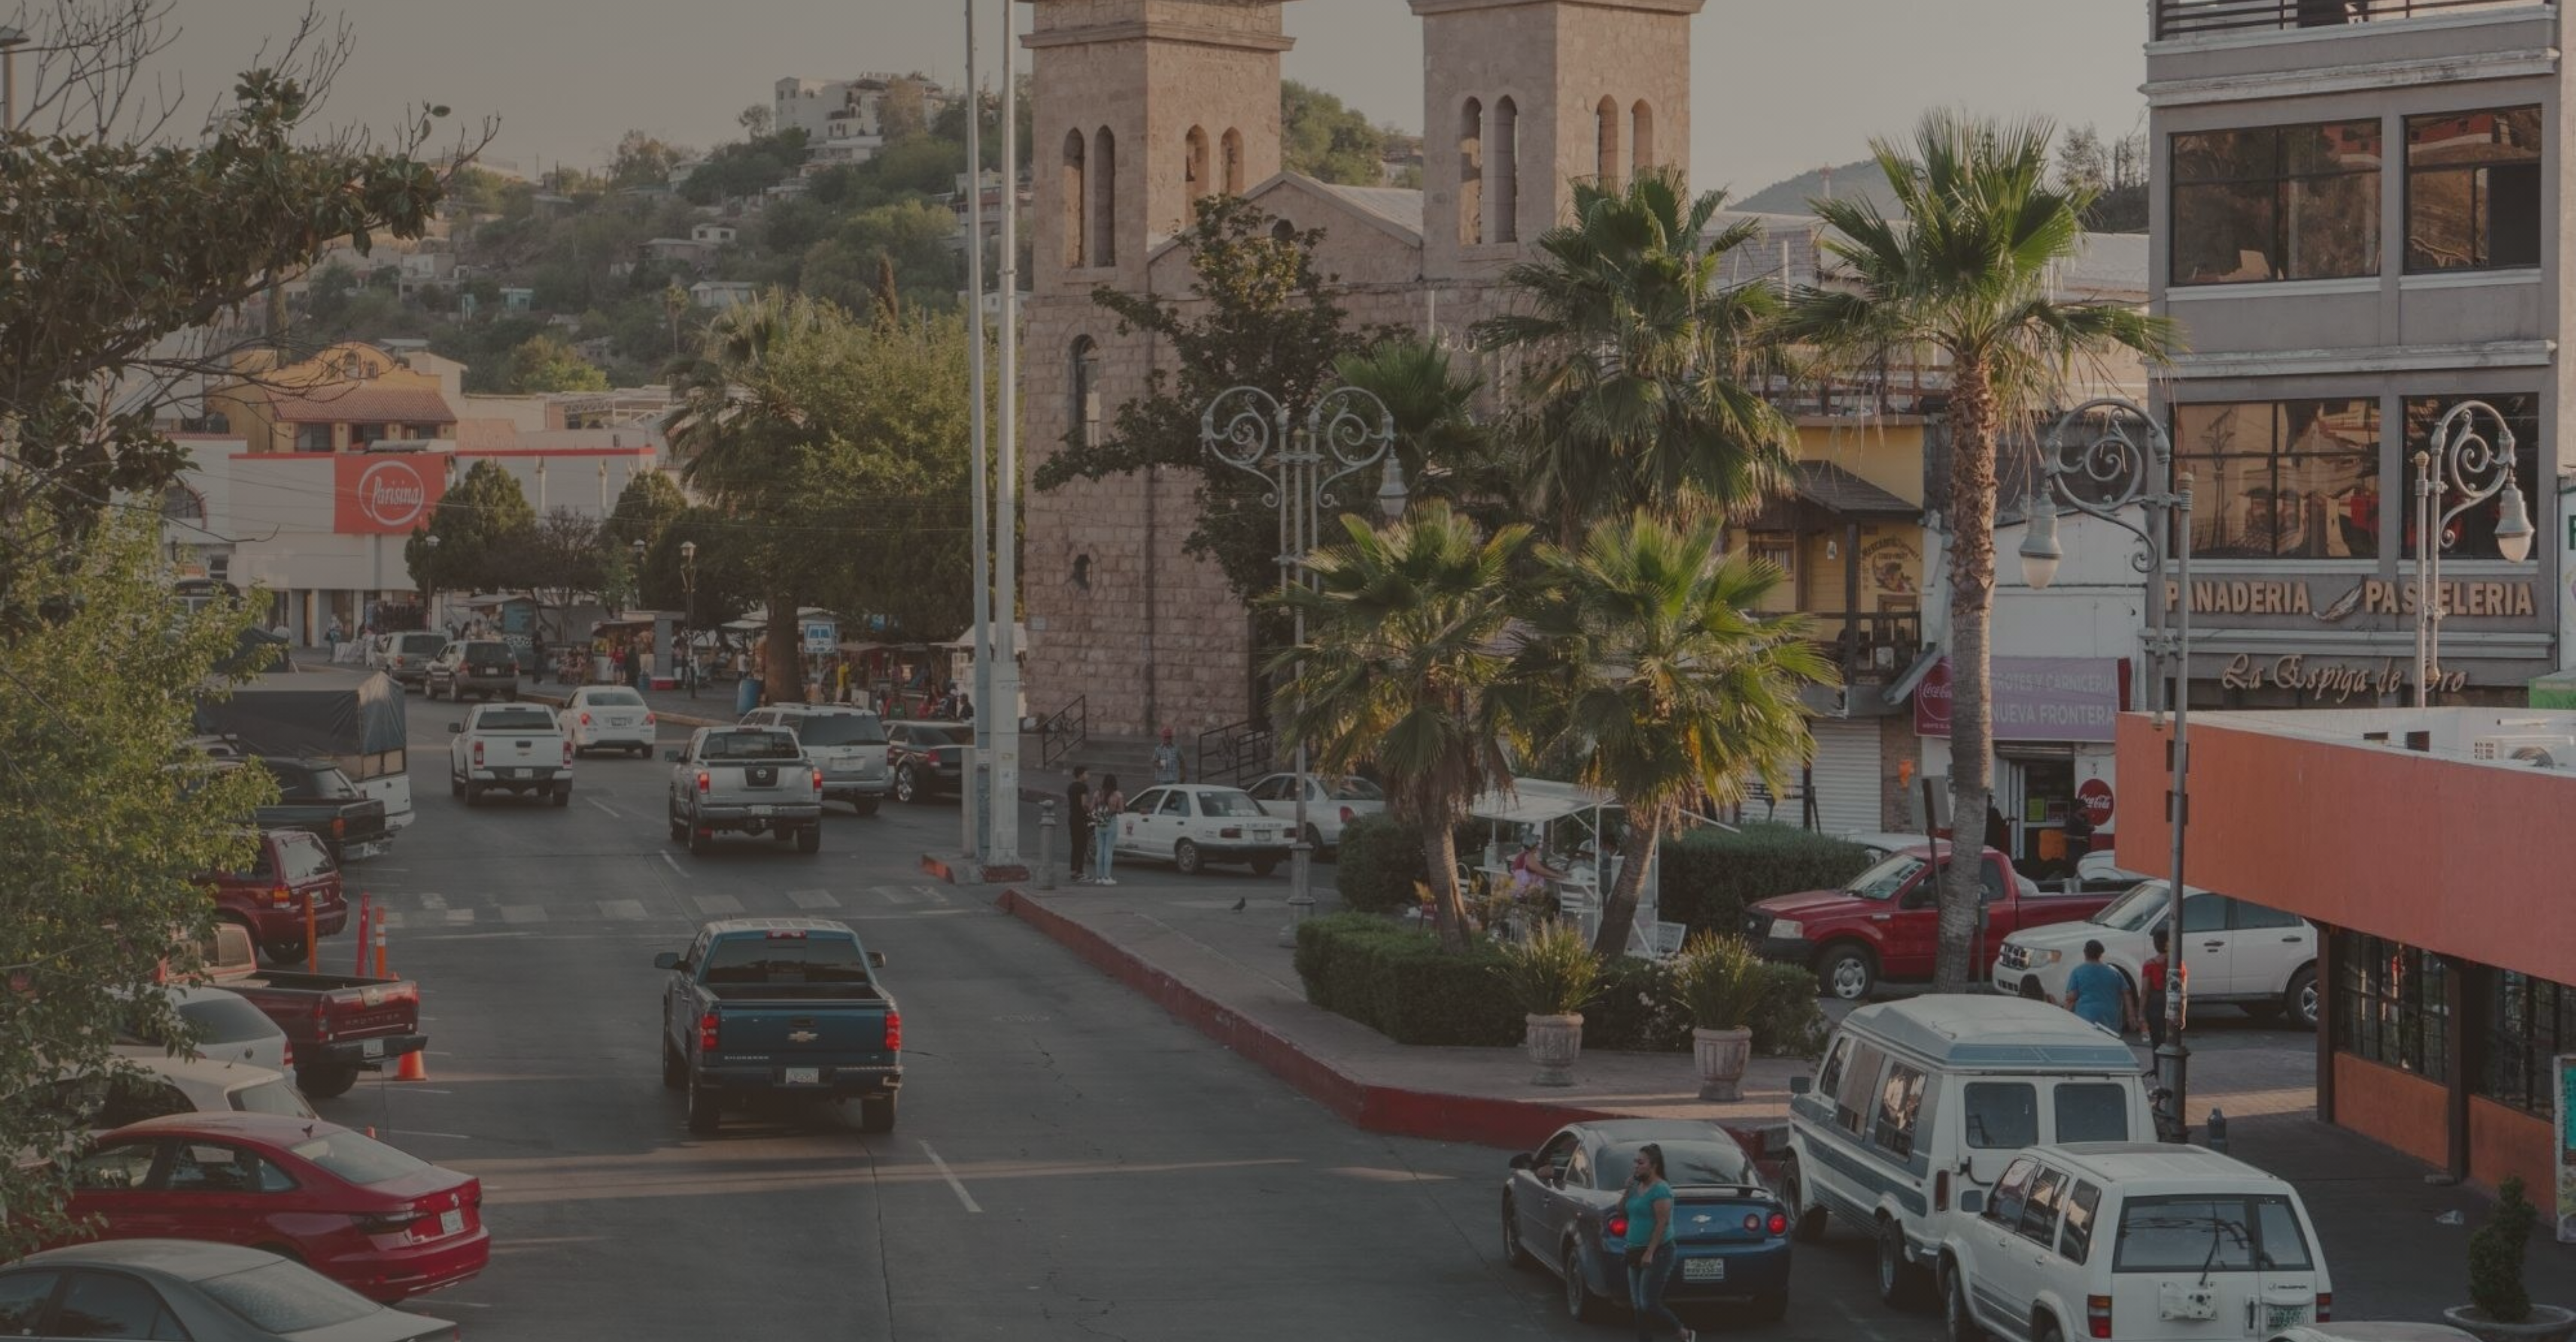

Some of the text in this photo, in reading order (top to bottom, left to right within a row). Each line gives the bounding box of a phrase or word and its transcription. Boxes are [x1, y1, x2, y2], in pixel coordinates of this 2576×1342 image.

[372, 476, 419, 505] Parisina
[2365, 580, 2534, 615] PASELERIA
[2046, 671, 2115, 694] CARNICERIA
[2222, 654, 2263, 689] La
[2275, 654, 2367, 703] Espiga
[2376, 658, 2402, 695] de
[1991, 704, 2115, 725] NUEVA FRONTERA
